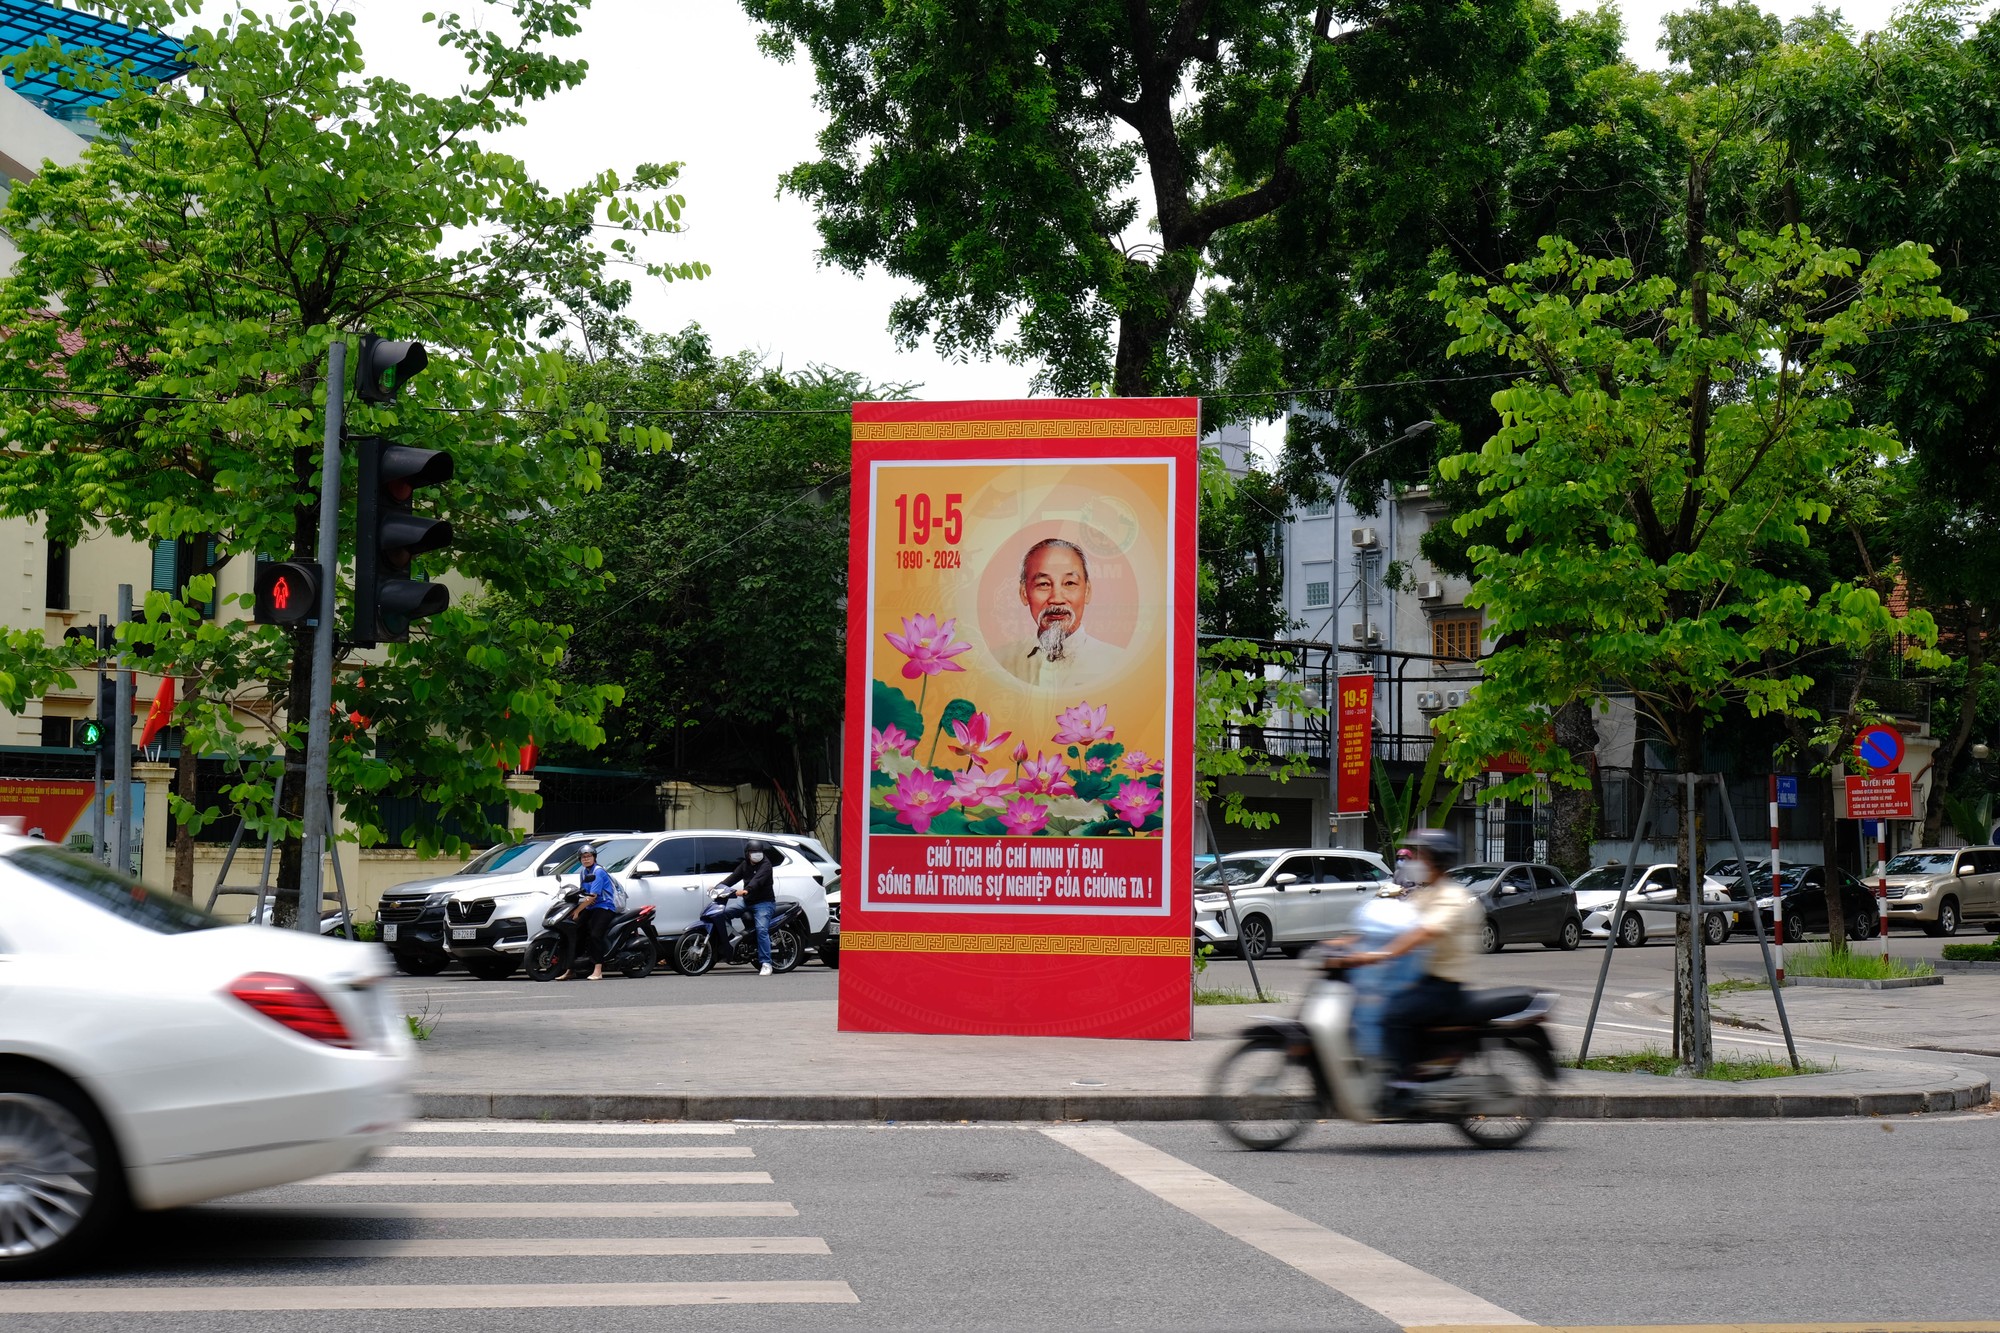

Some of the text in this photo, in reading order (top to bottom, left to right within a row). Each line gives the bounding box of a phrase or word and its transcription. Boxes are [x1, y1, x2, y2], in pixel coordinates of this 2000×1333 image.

[895, 493, 962, 545] 19-5
[896, 550, 923, 569] 1890
[933, 550, 961, 569] 2024
[1343, 689, 1367, 708] 19-5
[1882, 776, 1896, 786] PHỐ
[926, 839, 1103, 874] CHỦ TỊCH HỒ CHÍ MINH VĨ ĐẠI
[877, 866, 1153, 902] SỐNG MÃI TRONG SỰ NGHIỆP CỦA CHÚNG TA !
